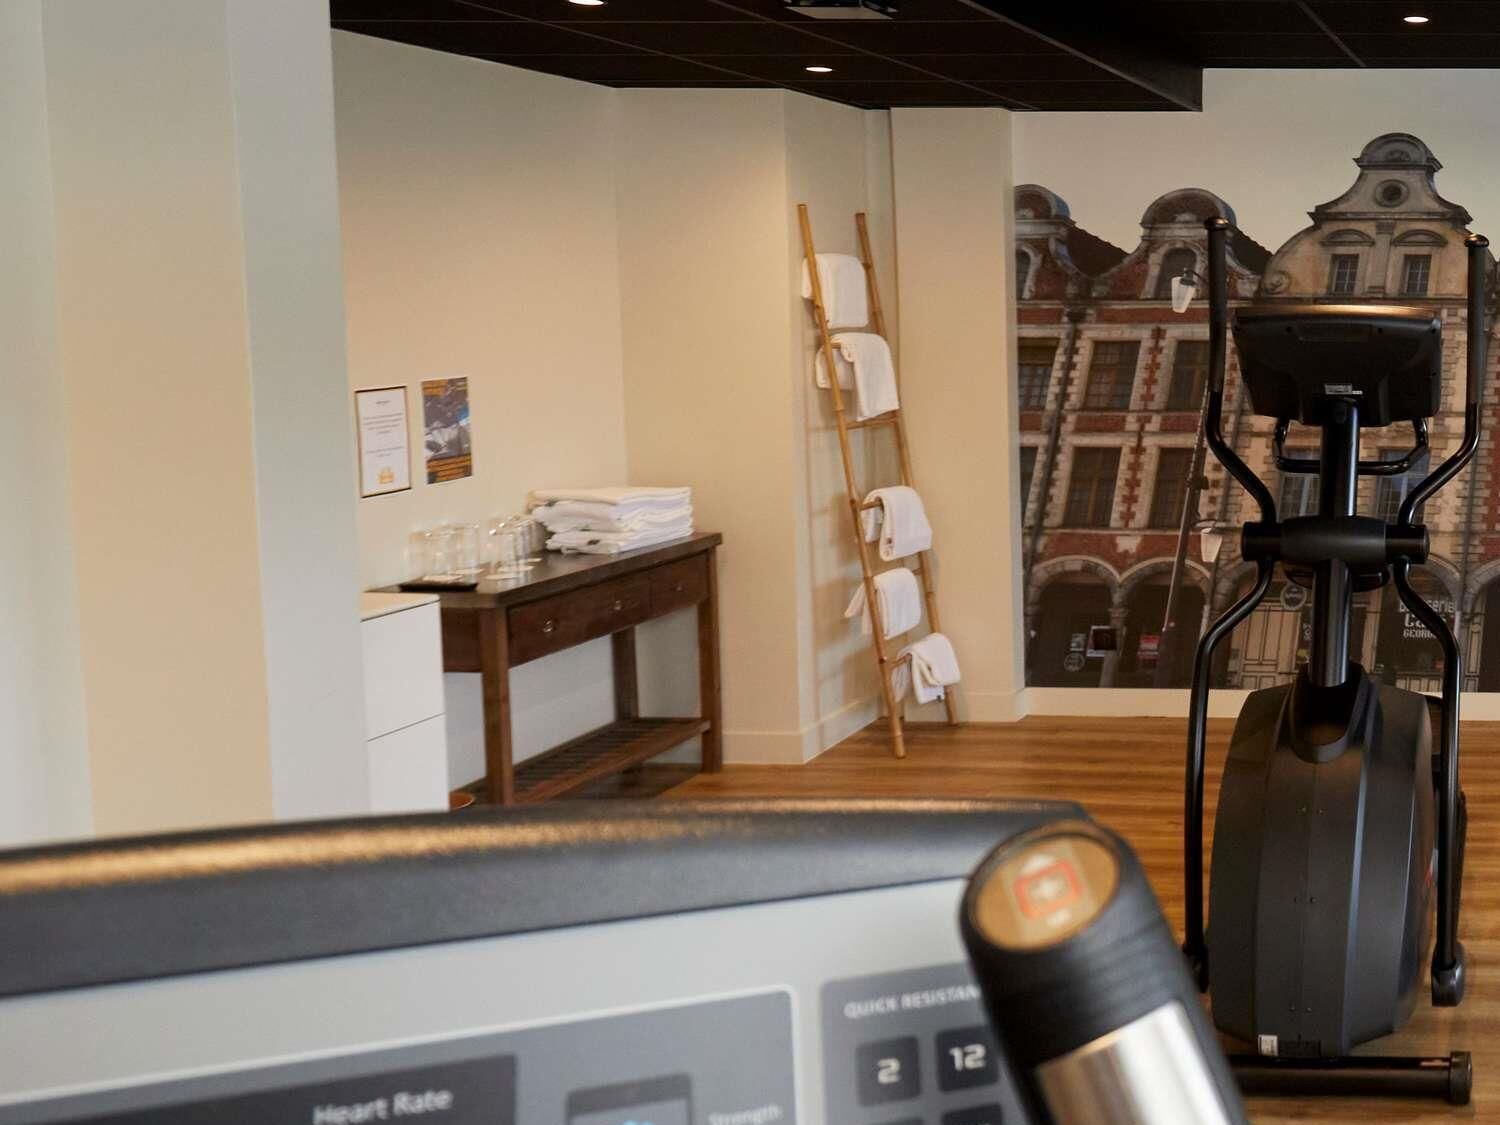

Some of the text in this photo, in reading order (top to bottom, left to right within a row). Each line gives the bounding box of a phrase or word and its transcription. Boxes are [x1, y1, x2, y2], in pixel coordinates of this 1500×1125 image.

[843, 985, 981, 1019] QUICK RESISTAN
[949, 1043, 986, 1071] 12
[877, 1058, 900, 1084] 2
[393, 1090, 453, 1116] Rate
